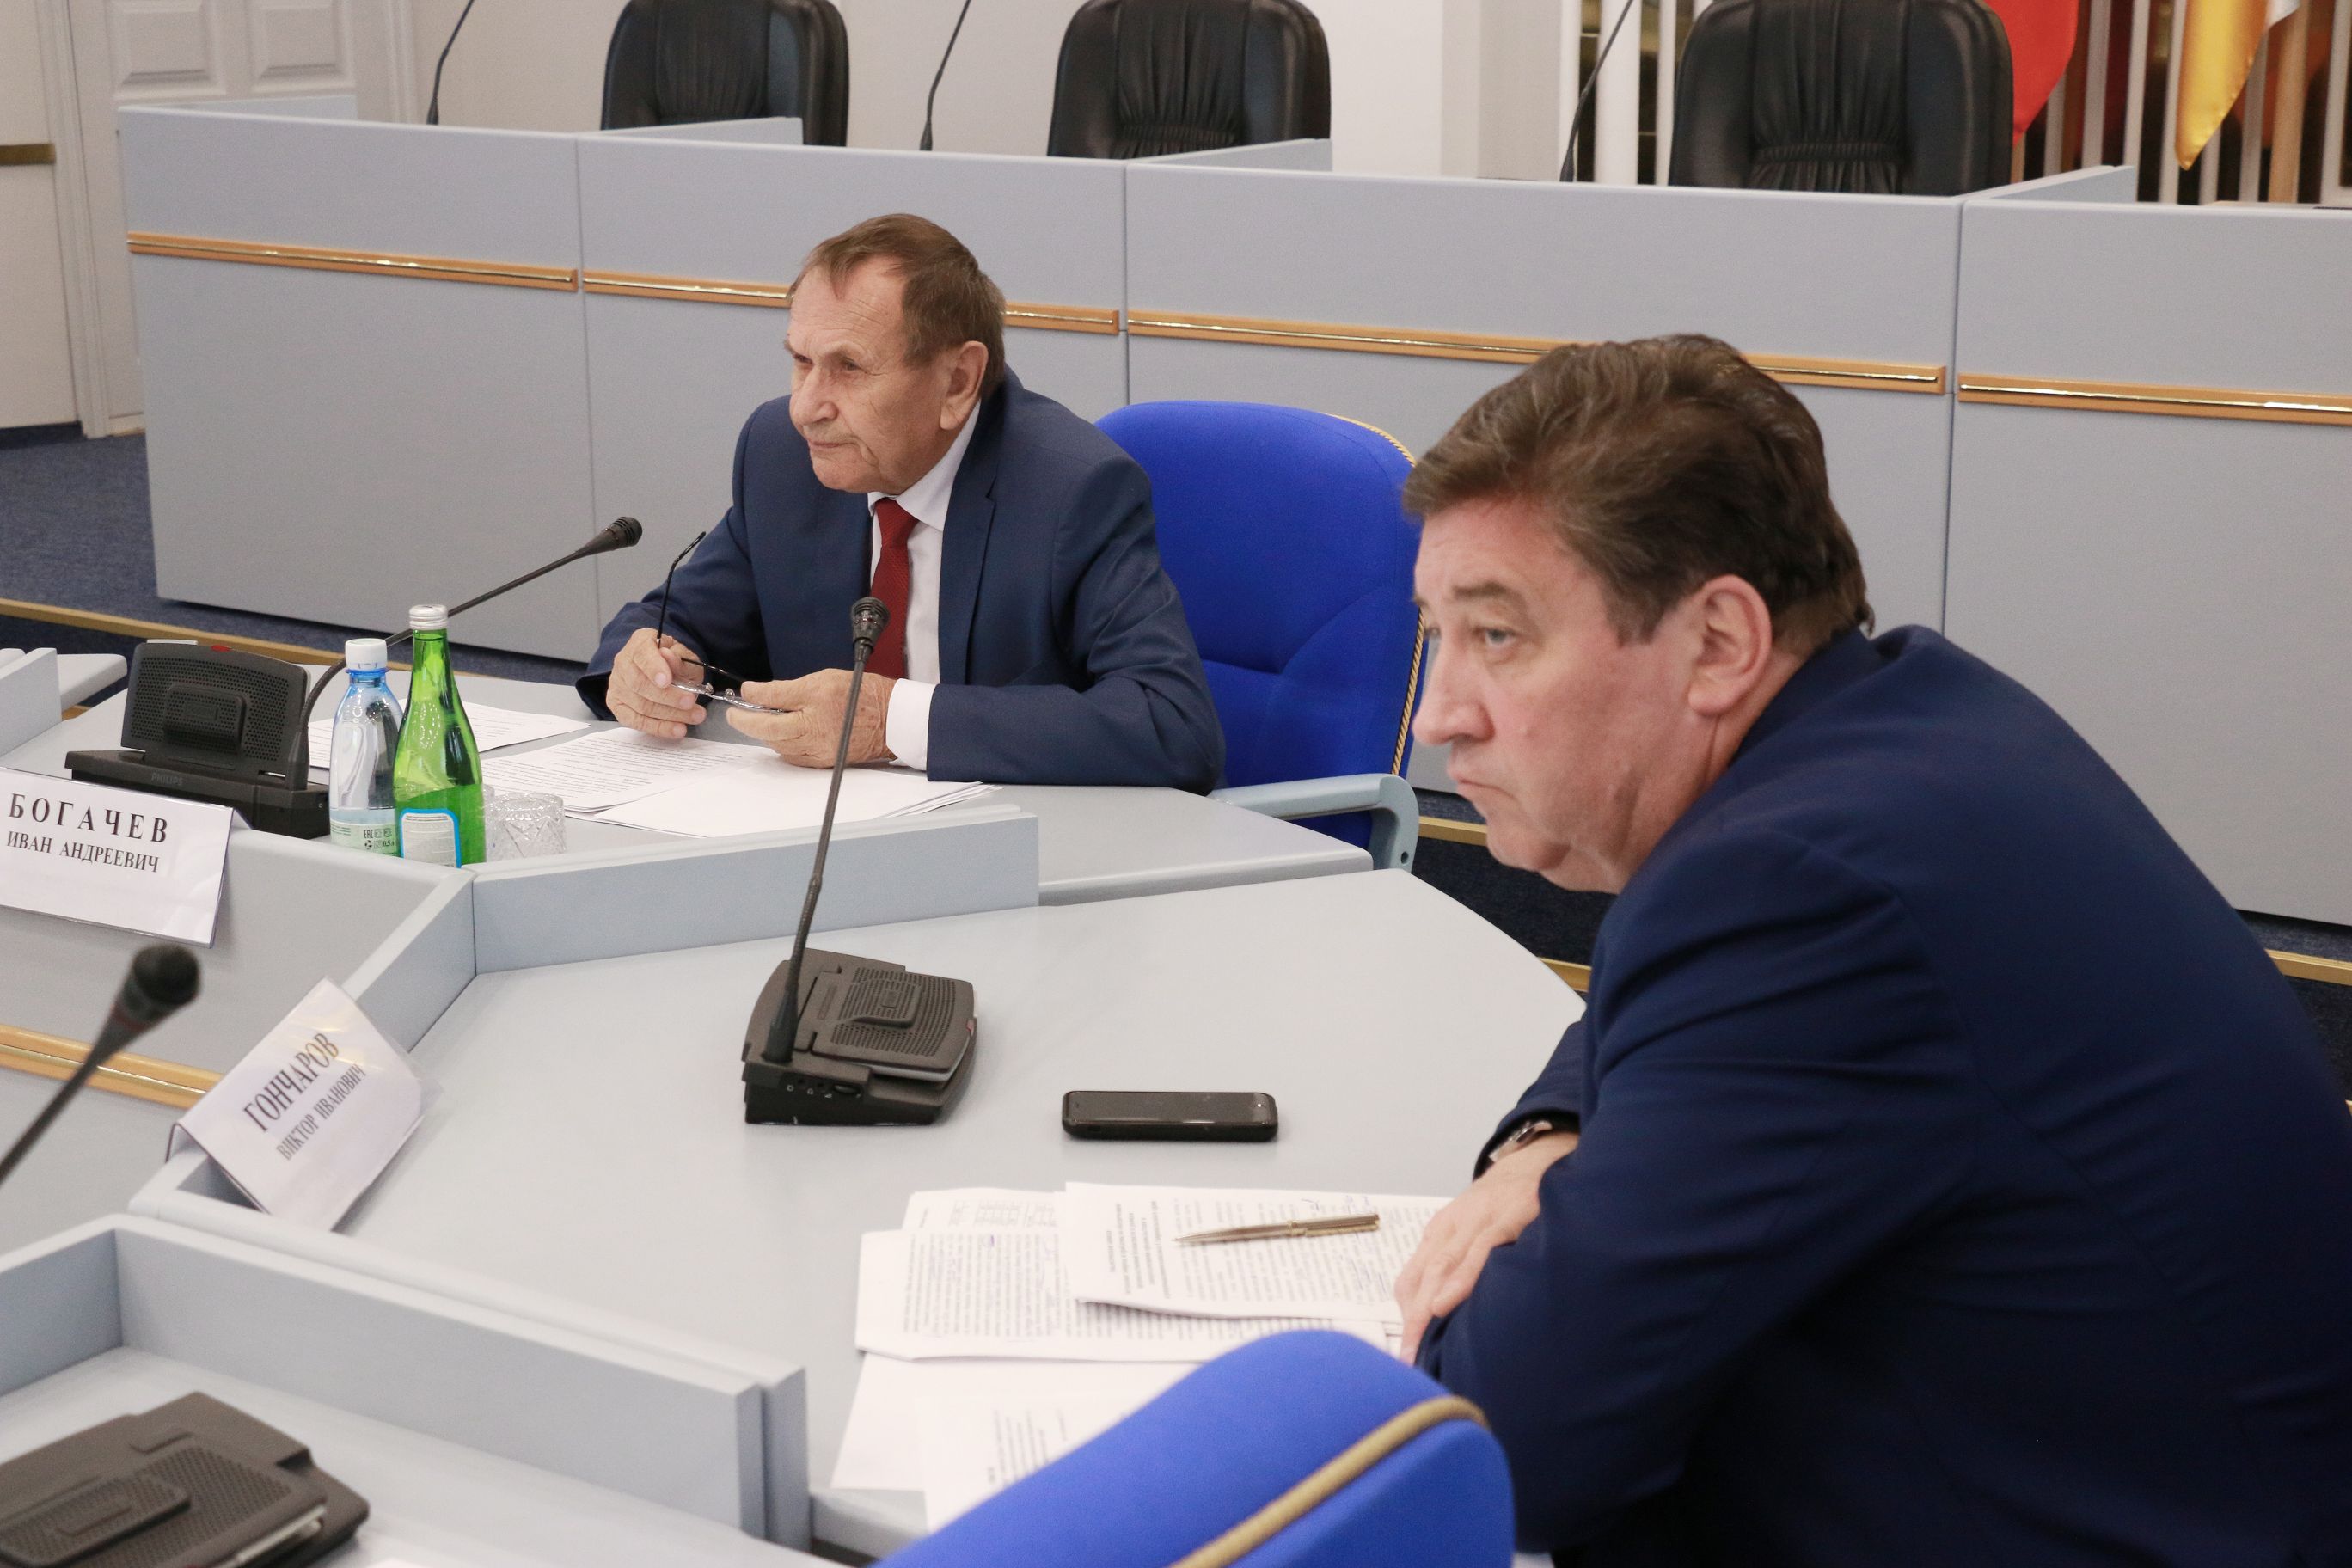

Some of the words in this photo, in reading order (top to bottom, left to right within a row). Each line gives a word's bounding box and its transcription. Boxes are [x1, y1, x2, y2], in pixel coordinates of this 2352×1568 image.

[6, 830, 52, 854] ИВАН
[59, 842, 160, 873] АНДРЕЕВИЧ
[9, 793, 168, 842] БОГАЧЕВ
[243, 1033, 339, 1132] ГОНЧАРОВ
[276, 1114, 319, 1160] ВИКТОР
[314, 1064, 366, 1119] ИВАНОВИЧ
